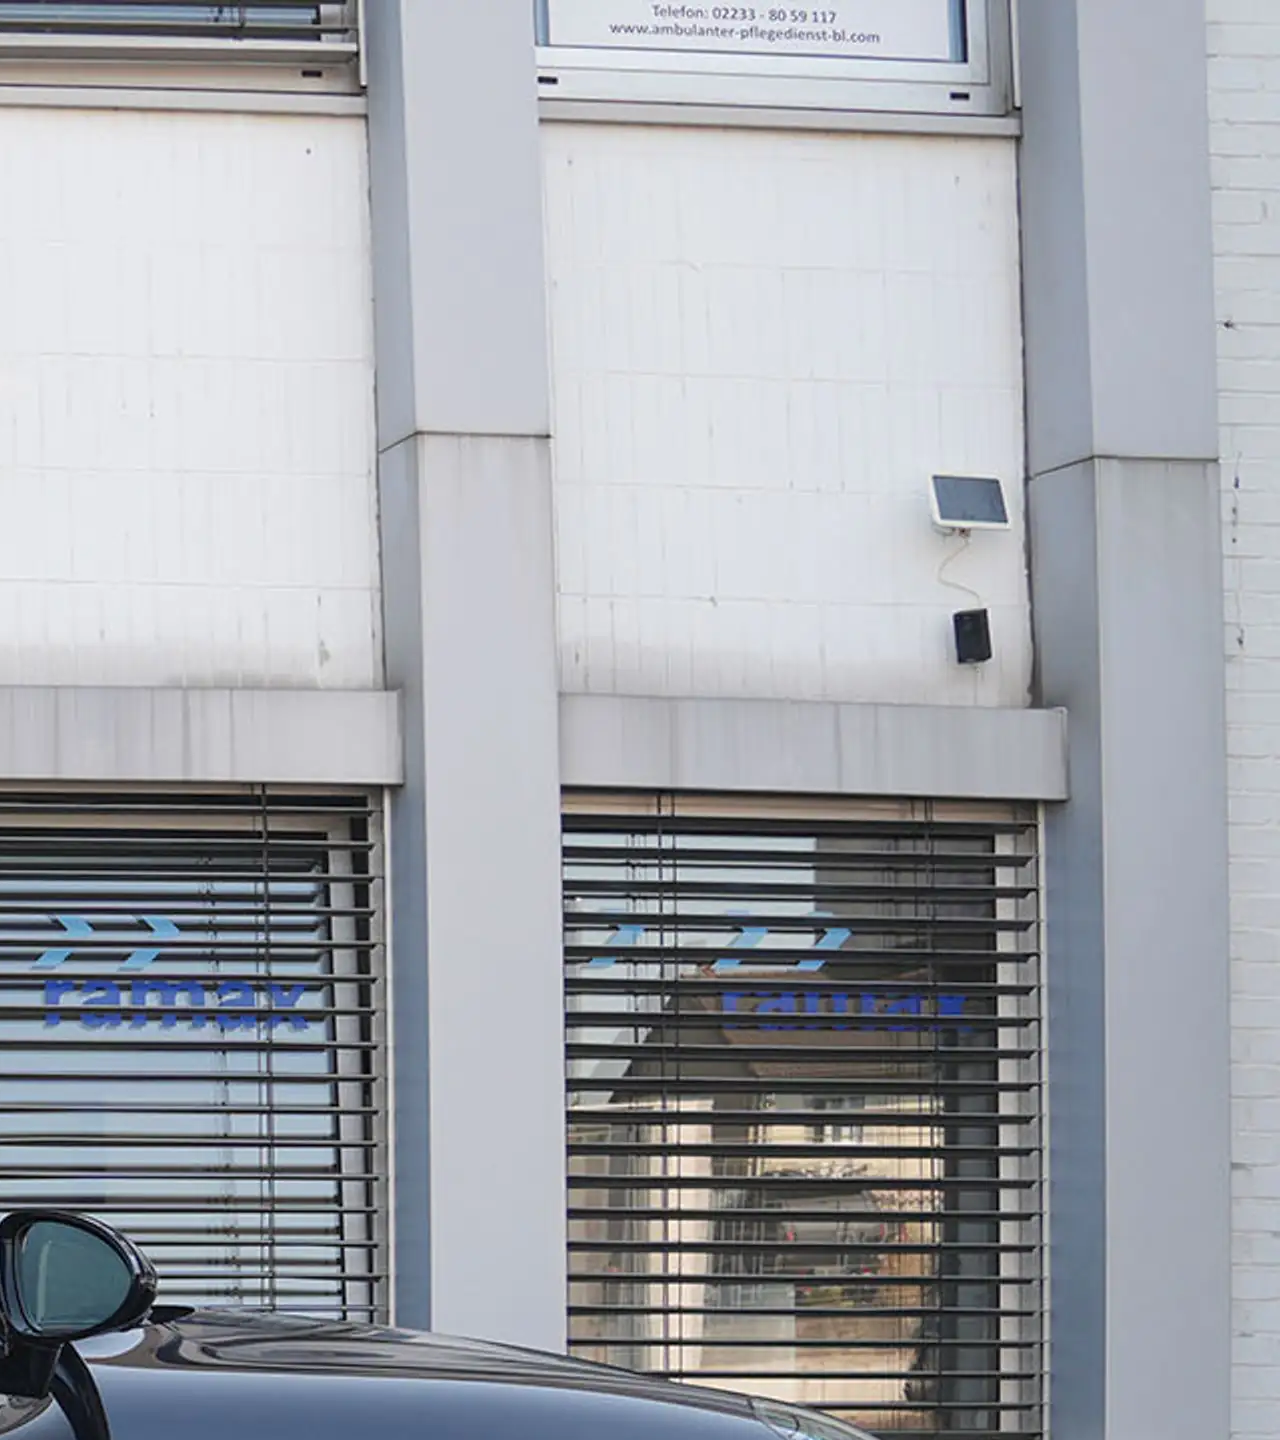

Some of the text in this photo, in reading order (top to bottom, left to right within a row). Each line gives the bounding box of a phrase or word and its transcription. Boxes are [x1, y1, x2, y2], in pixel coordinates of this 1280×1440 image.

[651, 4, 709, 20] Telefon:
[712, 7, 756, 21] 02233
[768, 9, 787, 22] 80
[790, 10, 808, 22] 59
[811, 10, 837, 24] 117
[609, 22, 881, 44] www.ambulanter-pflegedienst-bl.com
[42, 979, 310, 1031] ramax
